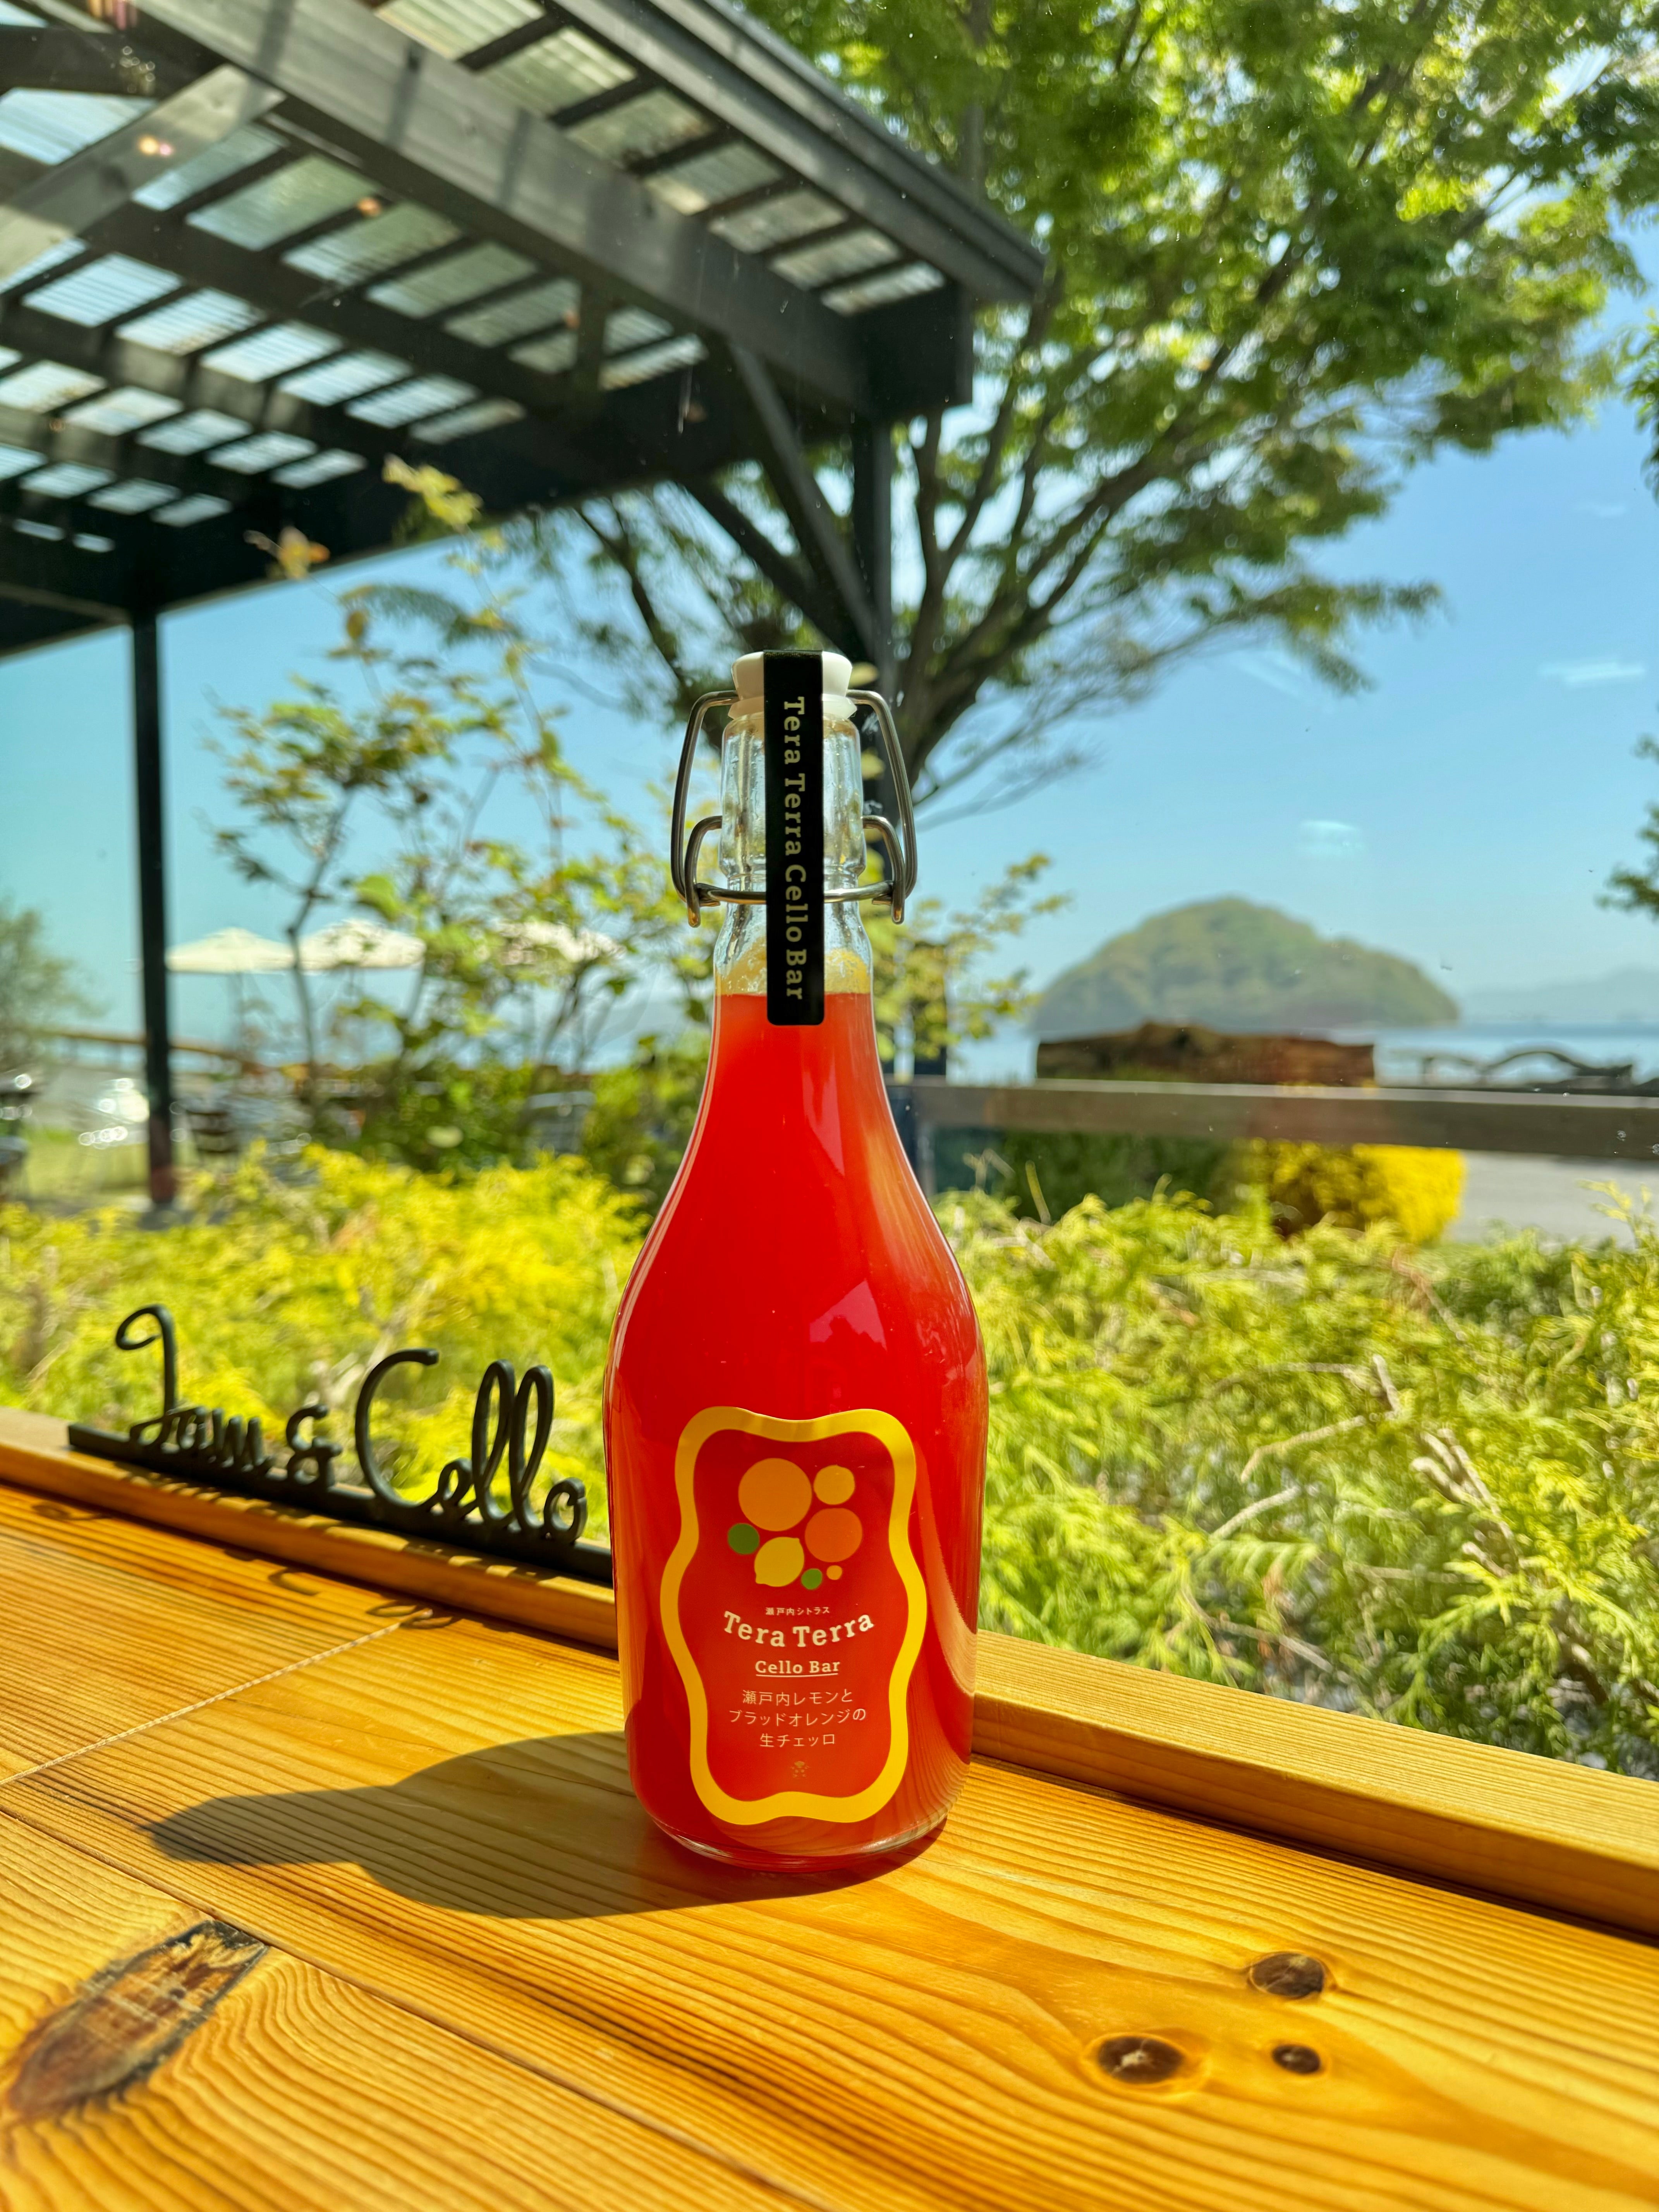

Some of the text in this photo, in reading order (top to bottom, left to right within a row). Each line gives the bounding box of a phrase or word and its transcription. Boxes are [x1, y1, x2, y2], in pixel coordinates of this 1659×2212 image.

[784, 697, 808, 1000] Tera Terra Cello Bar
[285, 1405, 342, 1486] &
[355, 1348, 588, 1543] Cello
[765, 1607, 830, 1616] 瀬戸内シトラス
[724, 1612, 874, 1647] Tera Terra
[755, 1660, 841, 1674] Cello Bar
[742, 1689, 853, 1706] 瀬戸内レモンと
[729, 1708, 866, 1726] ブラッドオレンジの
[760, 1733, 835, 1747] 生チェッロ
